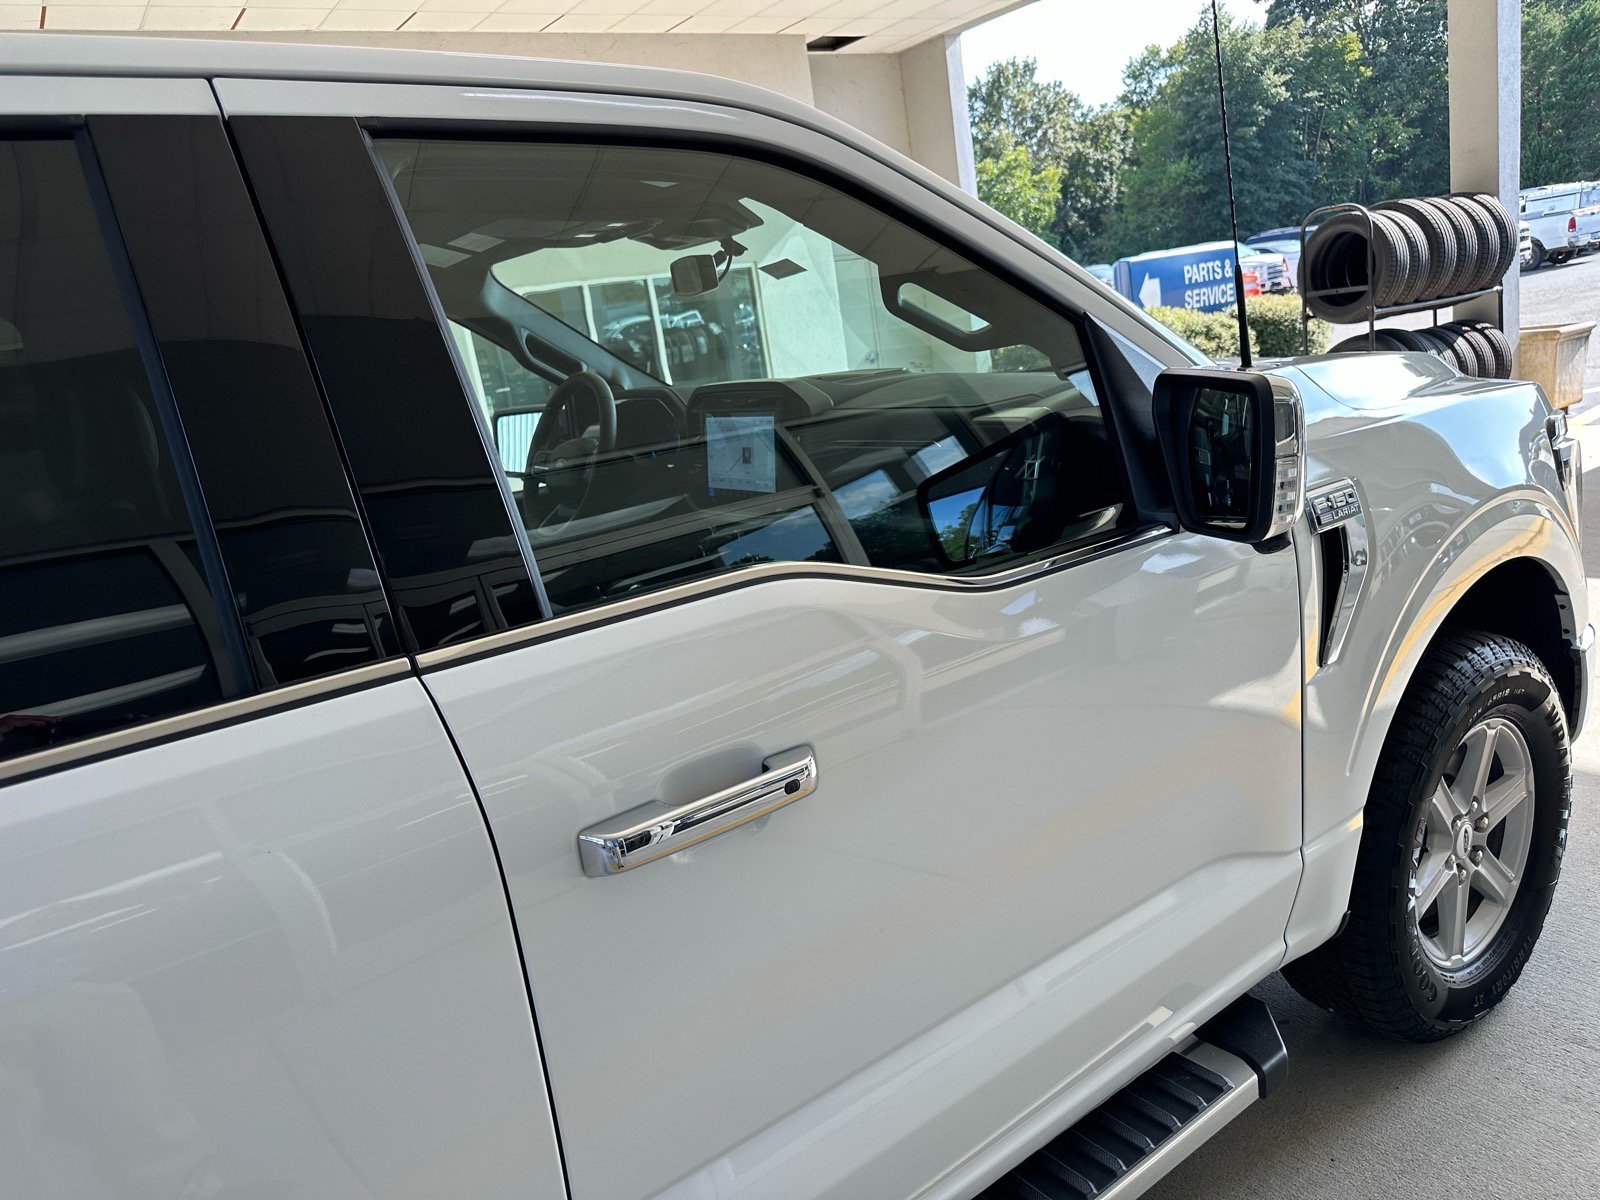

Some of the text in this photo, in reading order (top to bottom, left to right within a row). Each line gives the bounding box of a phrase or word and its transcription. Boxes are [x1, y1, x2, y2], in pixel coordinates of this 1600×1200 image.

[1184, 259, 1233, 284] PARTS &
[1184, 283, 1235, 309] SERVICE
[1313, 488, 1358, 515] F-150
[1333, 504, 1360, 519] LARIAT
[1405, 817, 1438, 1002] GOODYEAR
